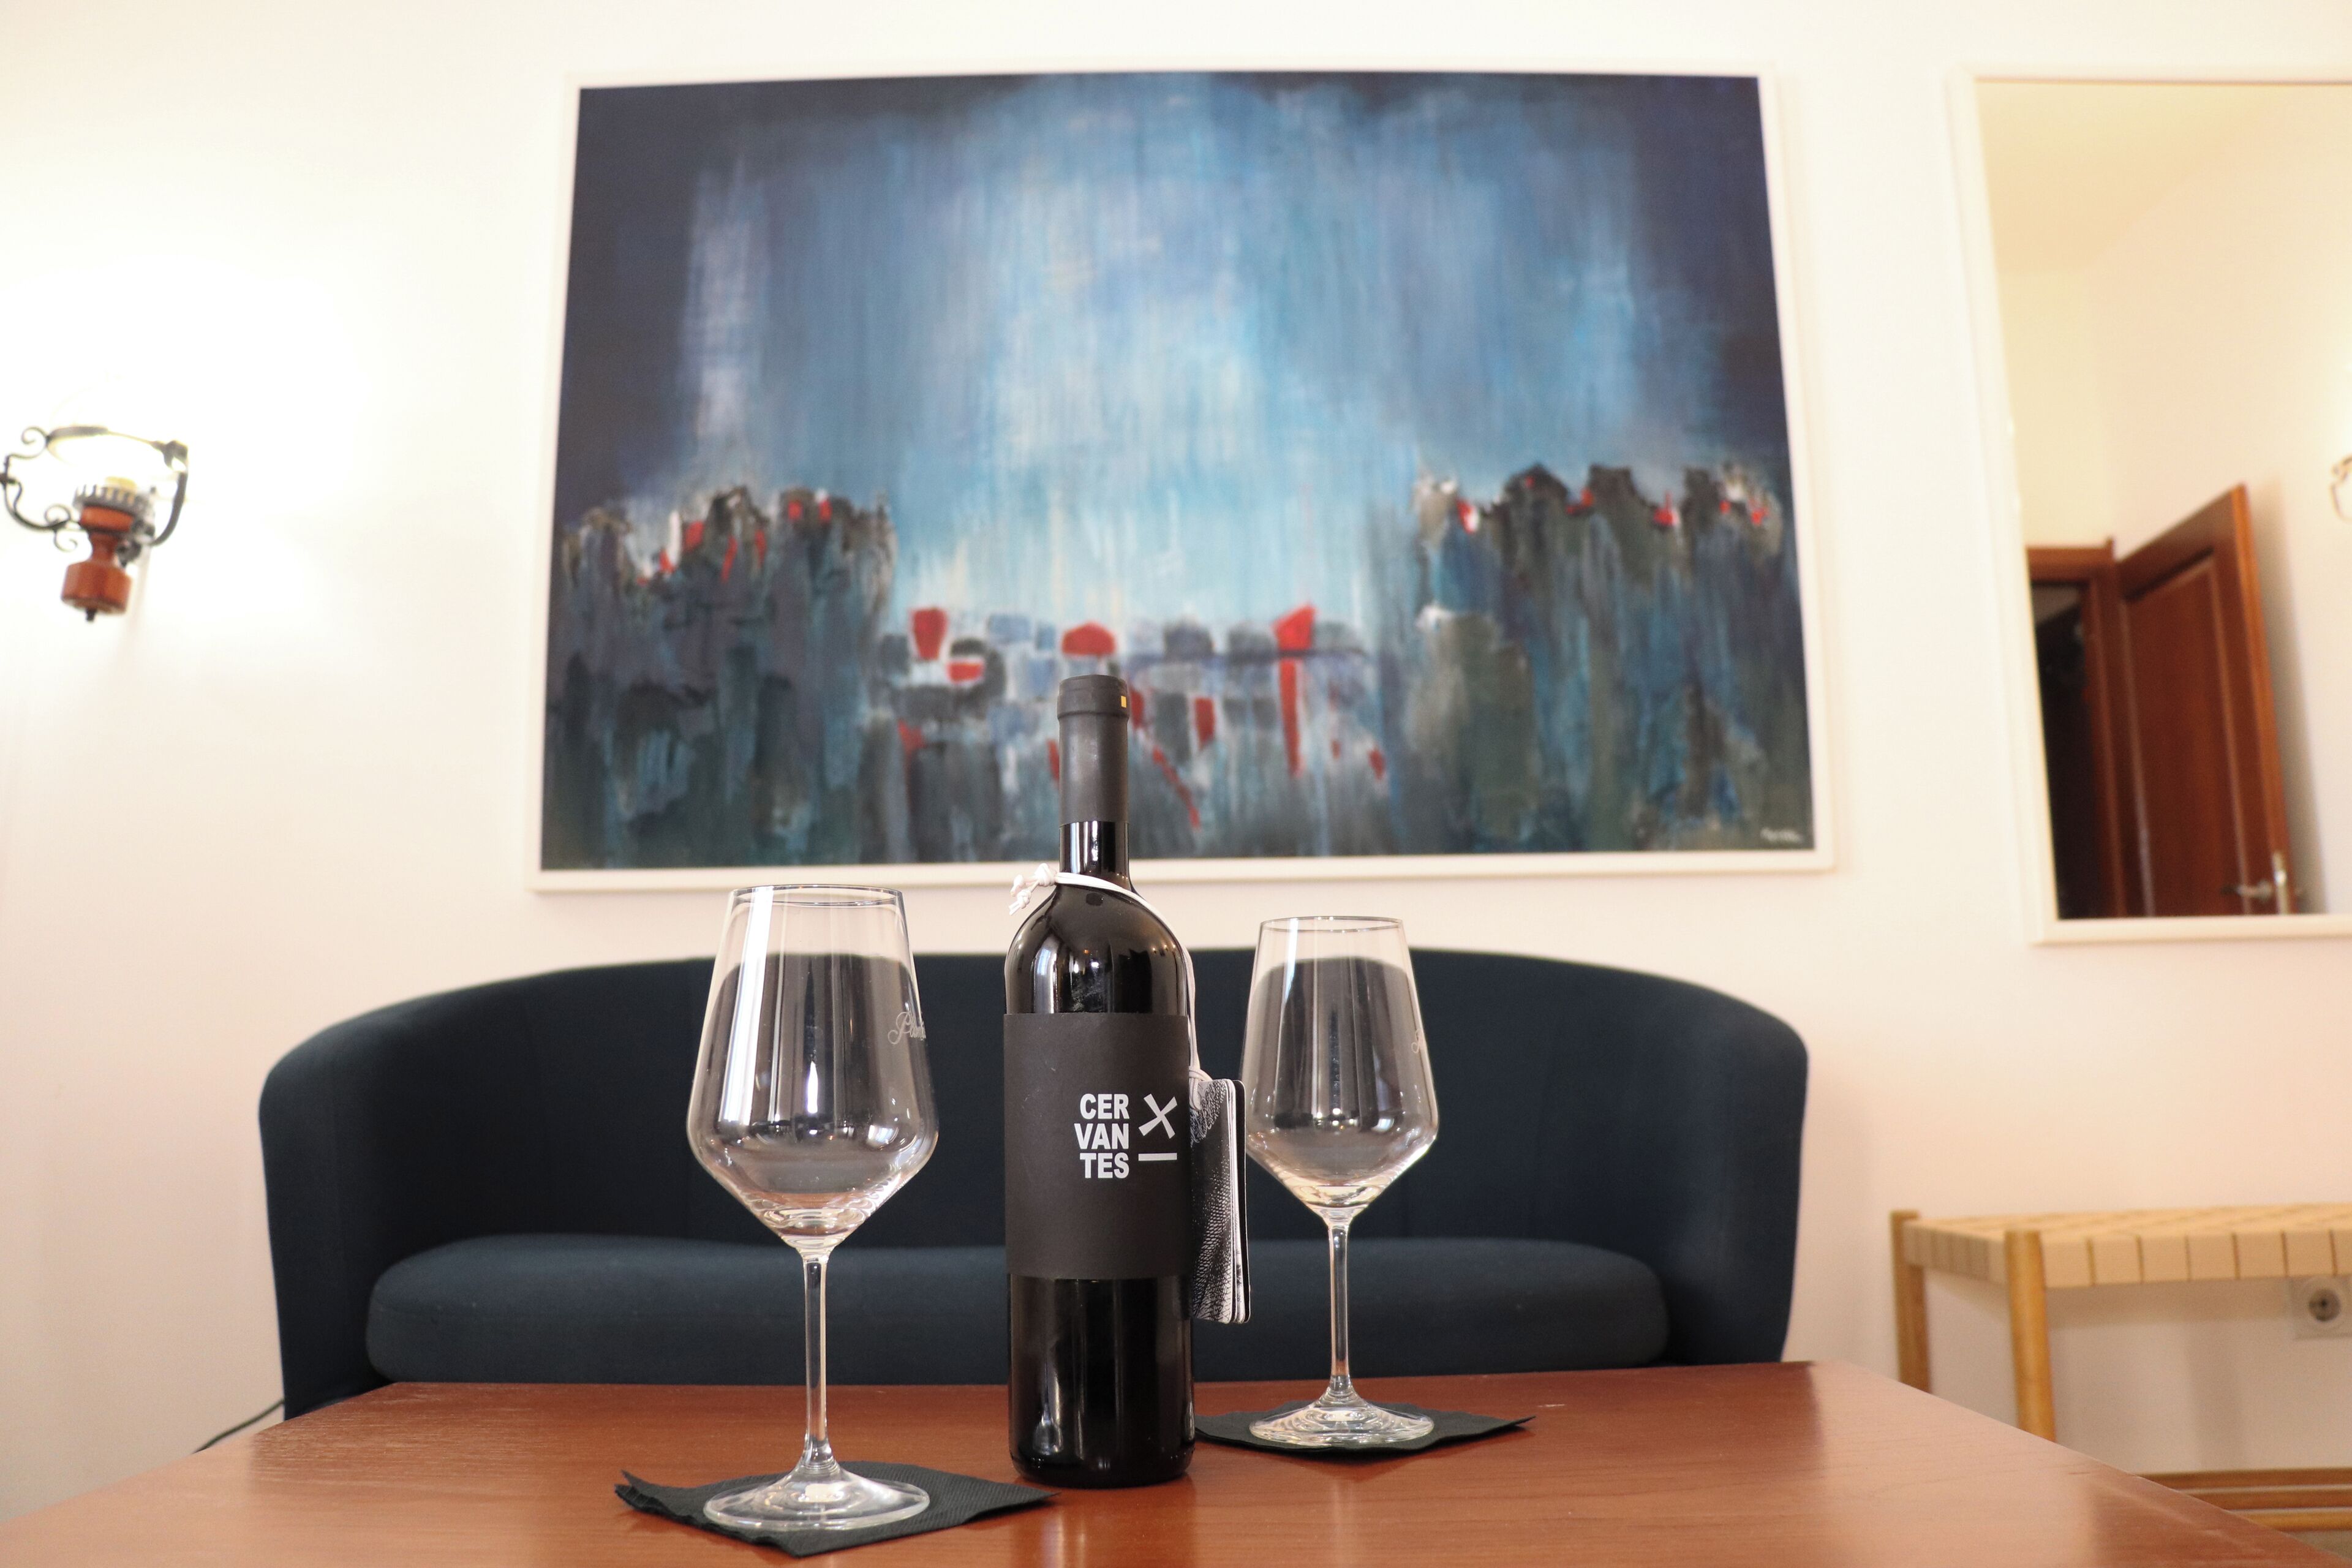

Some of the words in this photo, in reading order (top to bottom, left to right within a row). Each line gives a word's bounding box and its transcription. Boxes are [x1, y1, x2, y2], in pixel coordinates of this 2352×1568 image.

[1079, 1093, 1130, 1120] CER
[1074, 1123, 1129, 1150] VAN
[1079, 1152, 1130, 1179] TES
